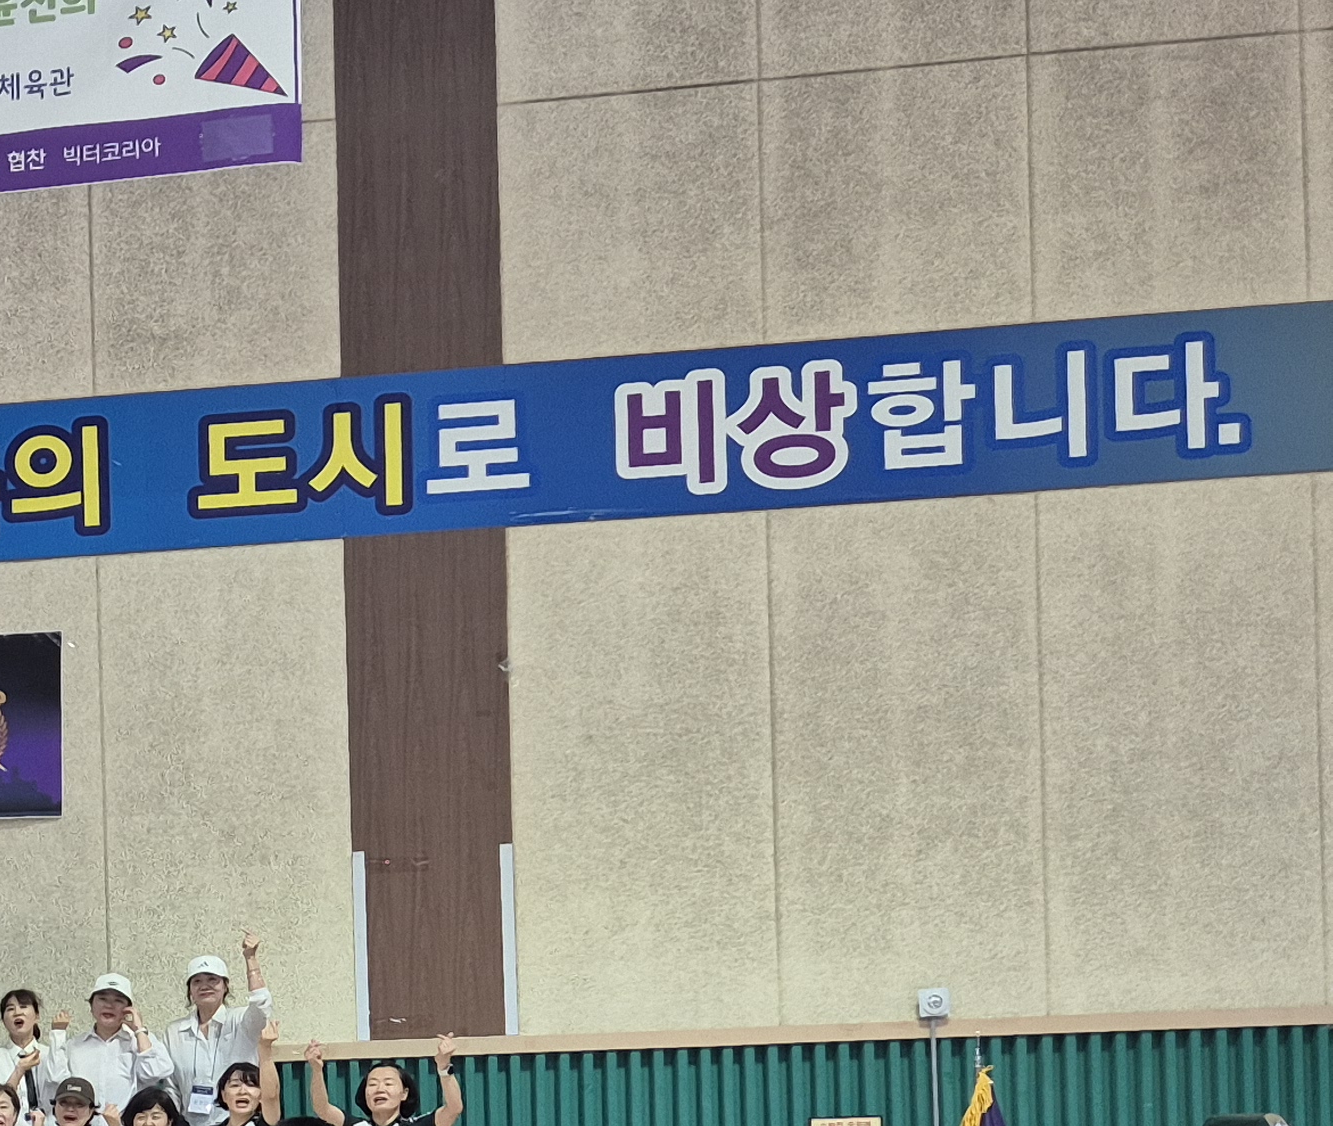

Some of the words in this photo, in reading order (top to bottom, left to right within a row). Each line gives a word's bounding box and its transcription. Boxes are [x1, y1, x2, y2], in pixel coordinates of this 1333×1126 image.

[7, 148, 47, 174] 협찬
[62, 135, 162, 168] 빅터코리아
[191, 393, 534, 515] 도시로
[618, 337, 1246, 494] 비상합니다.
